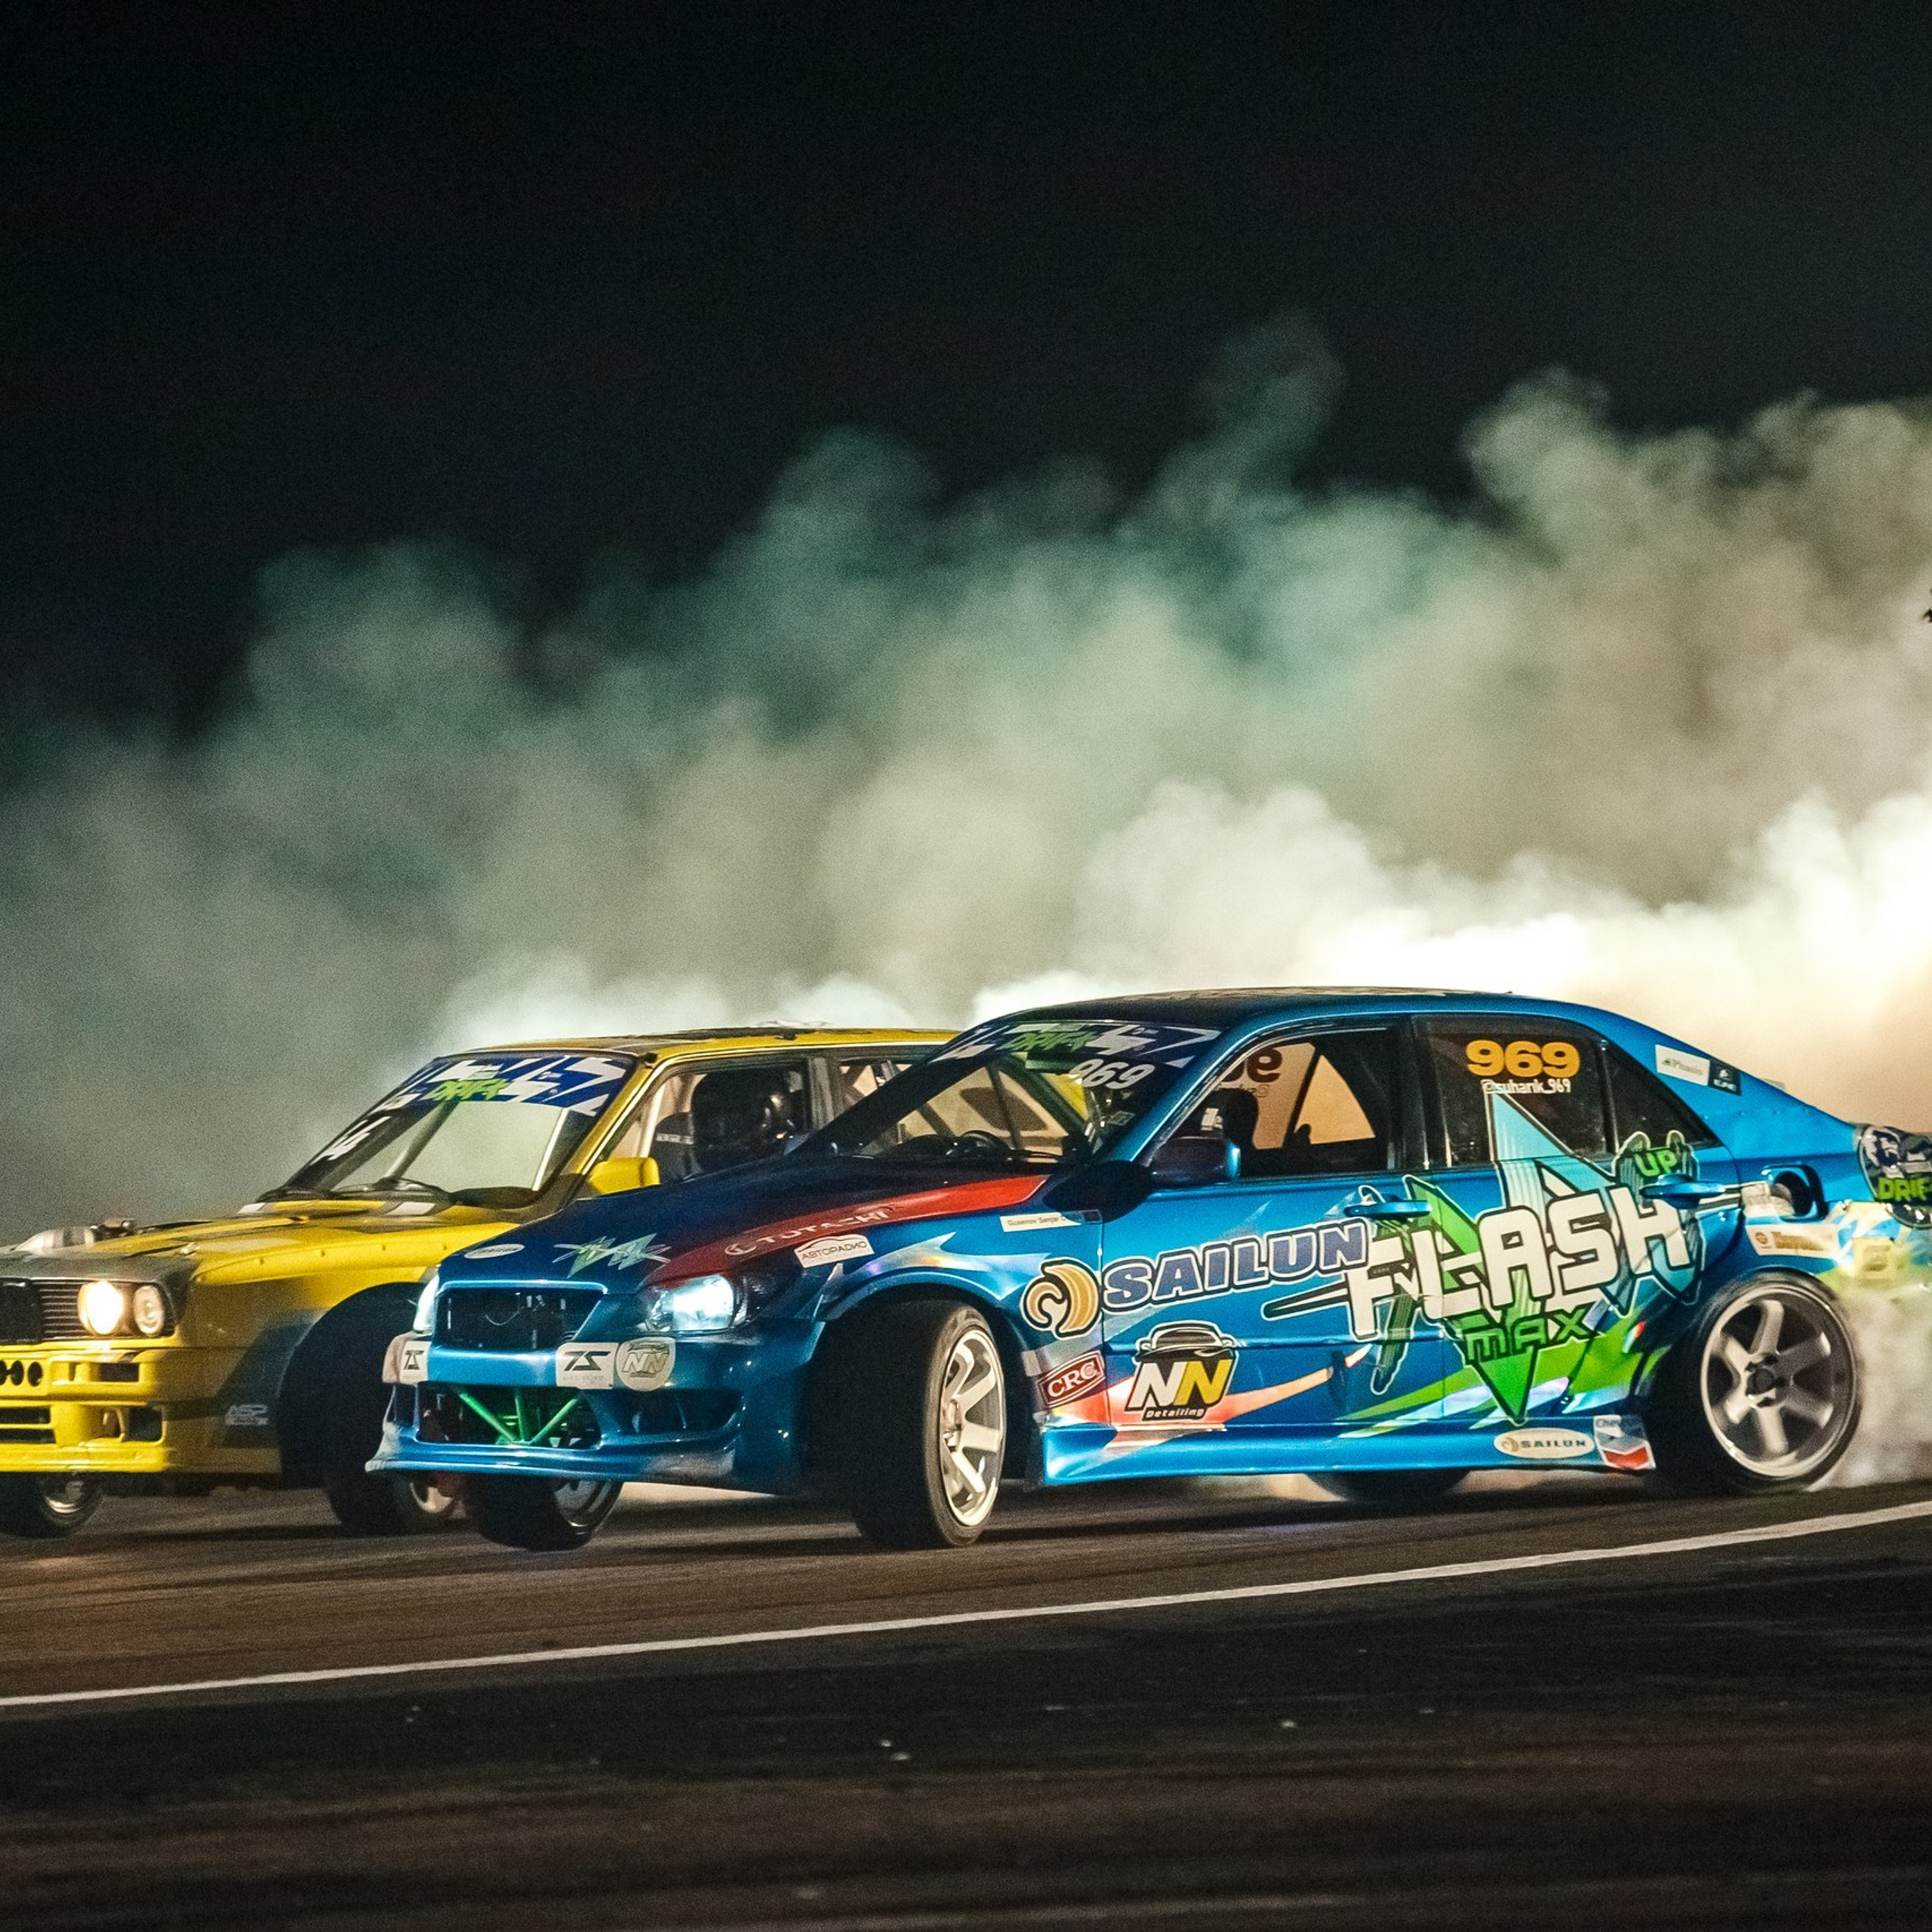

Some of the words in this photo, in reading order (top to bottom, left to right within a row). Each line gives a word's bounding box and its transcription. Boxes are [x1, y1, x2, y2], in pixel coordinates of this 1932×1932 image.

[1069, 1058, 1155, 1090] 969
[1466, 1039, 1580, 1078] 969
[1634, 1148, 1678, 1178] UP
[1878, 1177, 1932, 1201] DRIF
[801, 1240, 868, 1259] АВТОРАДИО
[1103, 1219, 1368, 1312] SAILUN
[1346, 1186, 1691, 1336] FLASH
[1047, 1360, 1099, 1398] CRC
[1129, 1359, 1232, 1407] NN
[1145, 1407, 1205, 1420] Detailing
[1521, 1439, 1586, 1449] SAILUN
